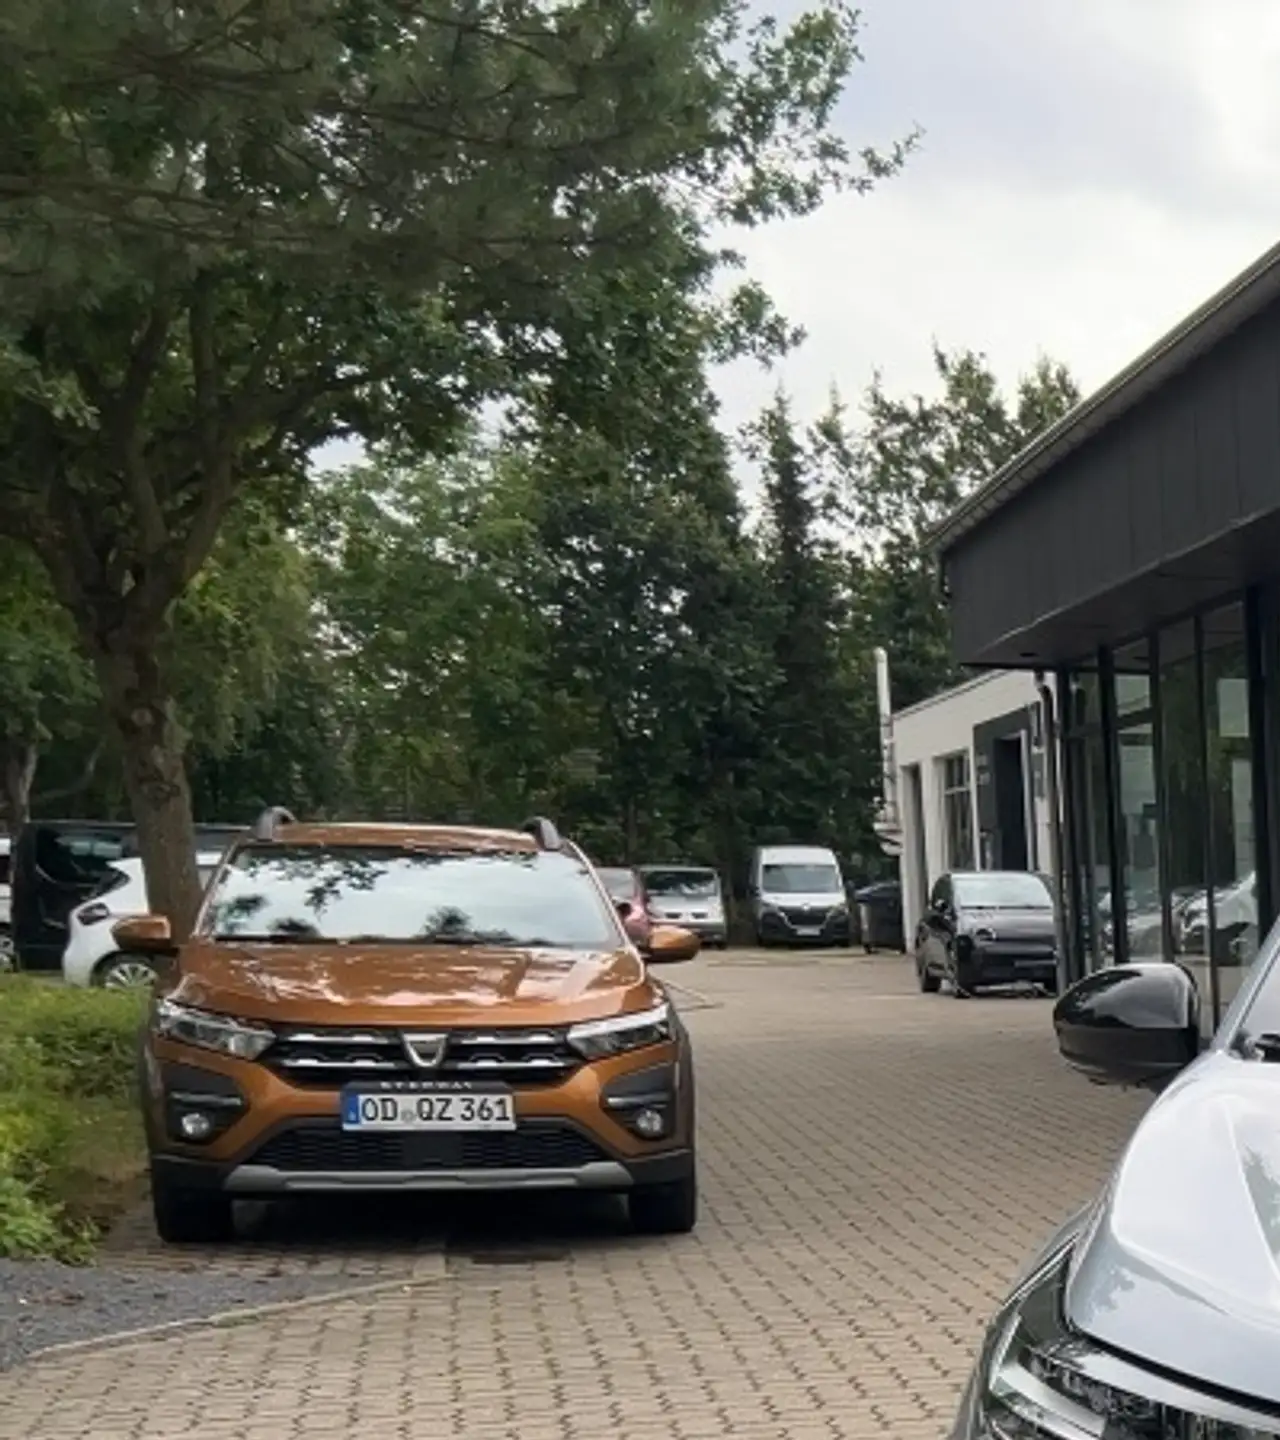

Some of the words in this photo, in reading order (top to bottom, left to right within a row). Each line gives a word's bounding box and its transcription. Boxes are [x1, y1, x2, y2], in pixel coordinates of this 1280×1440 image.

[361, 1097, 399, 1122] OD
[416, 1097, 455, 1122] QZ
[460, 1097, 511, 1122] 361
